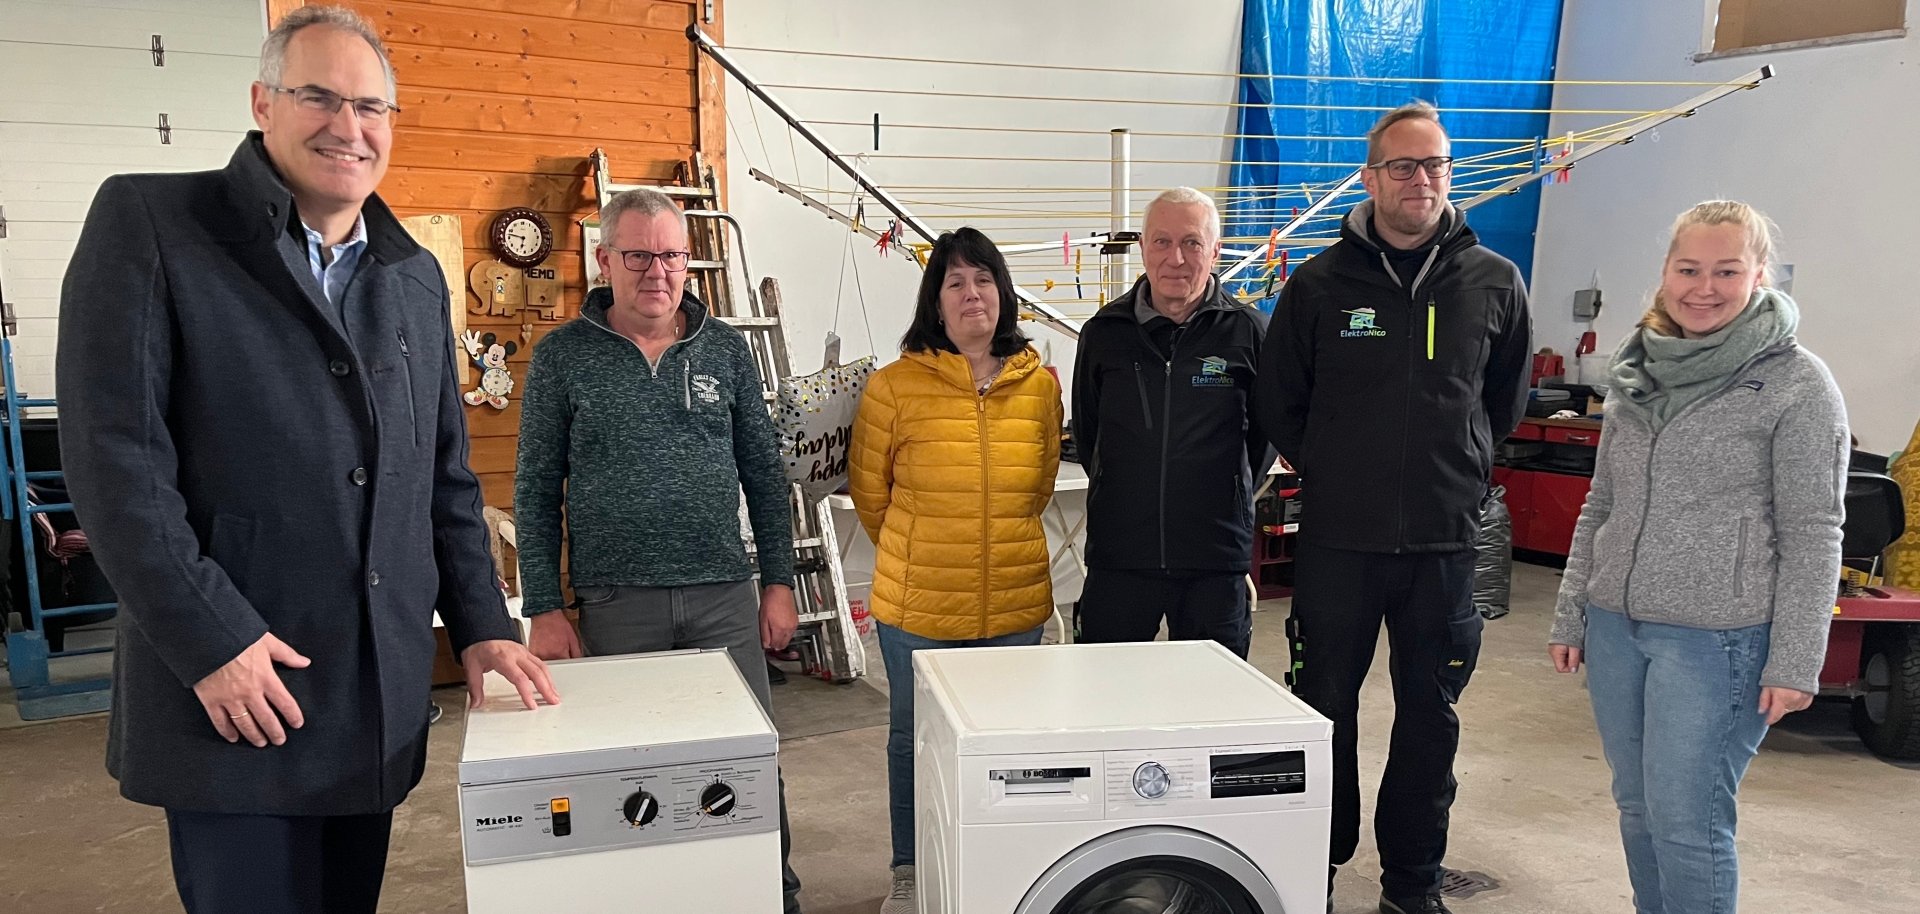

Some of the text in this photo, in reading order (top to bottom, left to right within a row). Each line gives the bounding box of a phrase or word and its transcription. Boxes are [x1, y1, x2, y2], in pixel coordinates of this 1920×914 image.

[524, 269, 555, 280] MEMO
[1340, 329, 1387, 338] ElektroNico
[1191, 375, 1235, 384] ElektroNico
[805, 455, 848, 482] ppy
[475, 815, 523, 827] Miele
